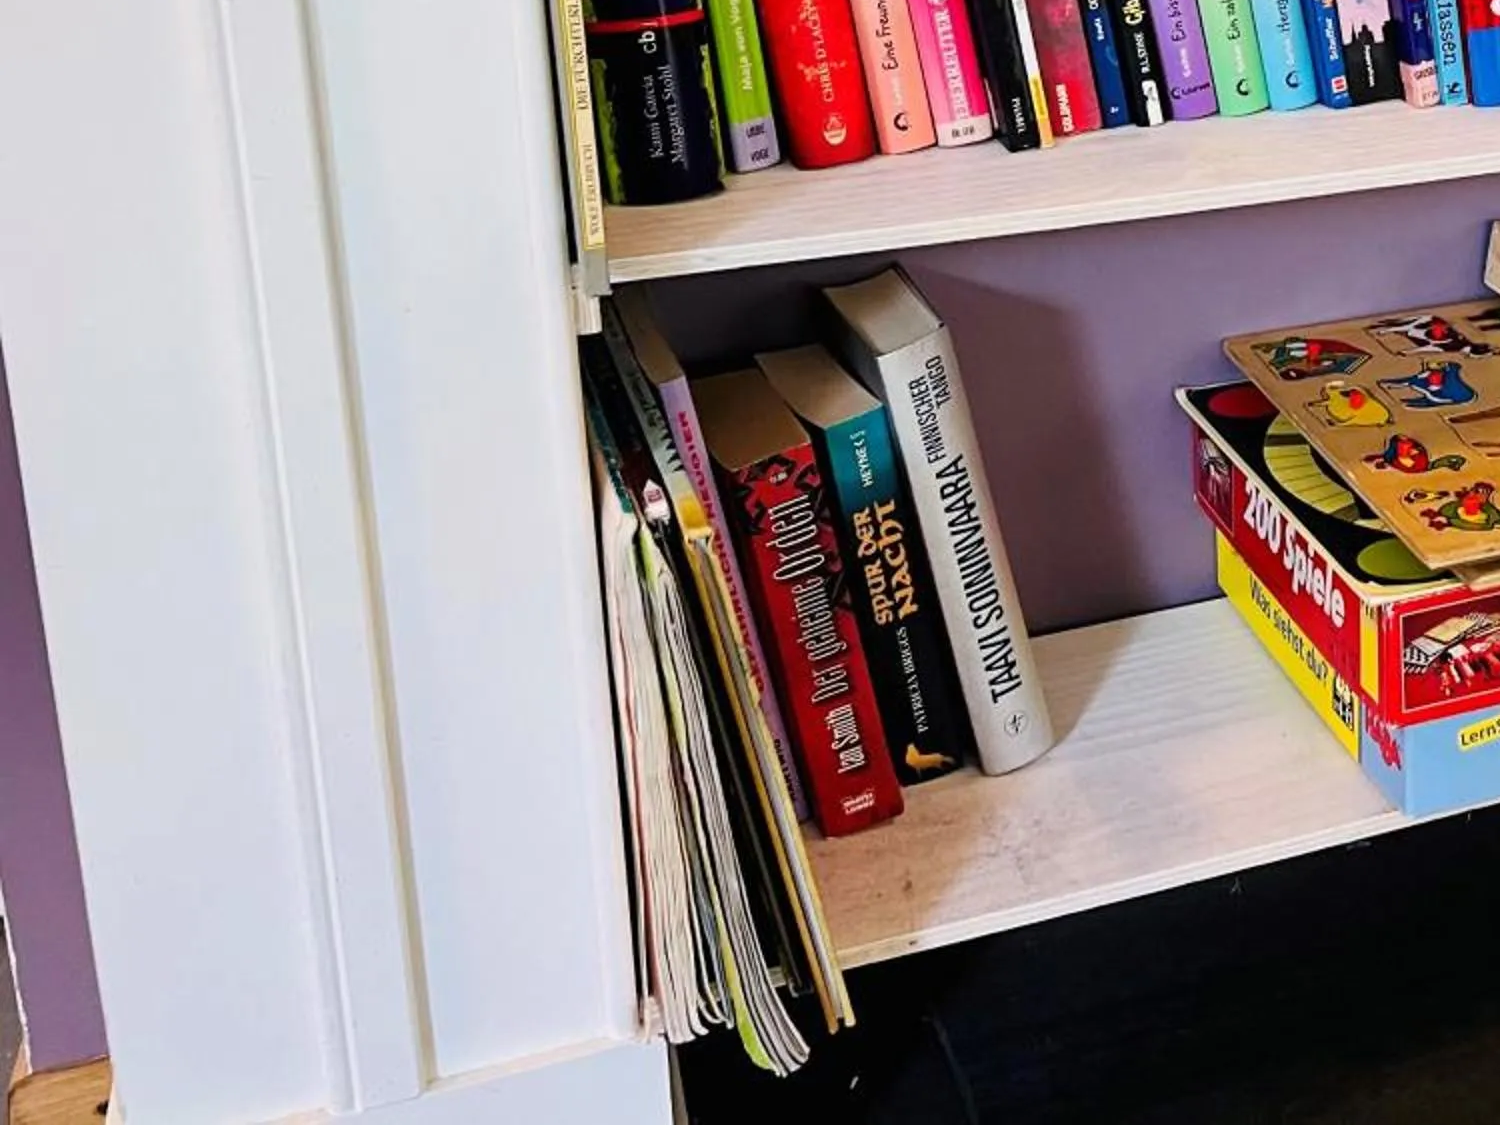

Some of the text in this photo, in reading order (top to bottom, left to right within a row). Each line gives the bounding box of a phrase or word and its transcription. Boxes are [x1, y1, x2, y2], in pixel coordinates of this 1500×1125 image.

[881, 39, 900, 72] Eine
[1171, 19, 1187, 43] Ein
[1227, 19, 1241, 42] Ein
[643, 74, 660, 120] Garcia
[740, 56, 754, 92] Maja
[814, 61, 835, 103] CHRIS
[656, 64, 685, 164] Margaret Stohl
[1055, 83, 1074, 134] GOLDMANN
[908, 355, 953, 464] FINNISCHER TANGO
[853, 445, 873, 488] HEYNE
[852, 506, 876, 562] DER
[1243, 480, 1346, 629] 200 Spiele
[765, 492, 850, 705] Der geheime Orden
[862, 561, 894, 626] SPUR
[935, 453, 1024, 704] TAAVI SOININVAARA
[1250, 571, 1272, 620] Was
[1305, 647, 1329, 686] du?
[896, 625, 930, 735] PATRICIA BRIGGS
[823, 703, 863, 750] Smith
